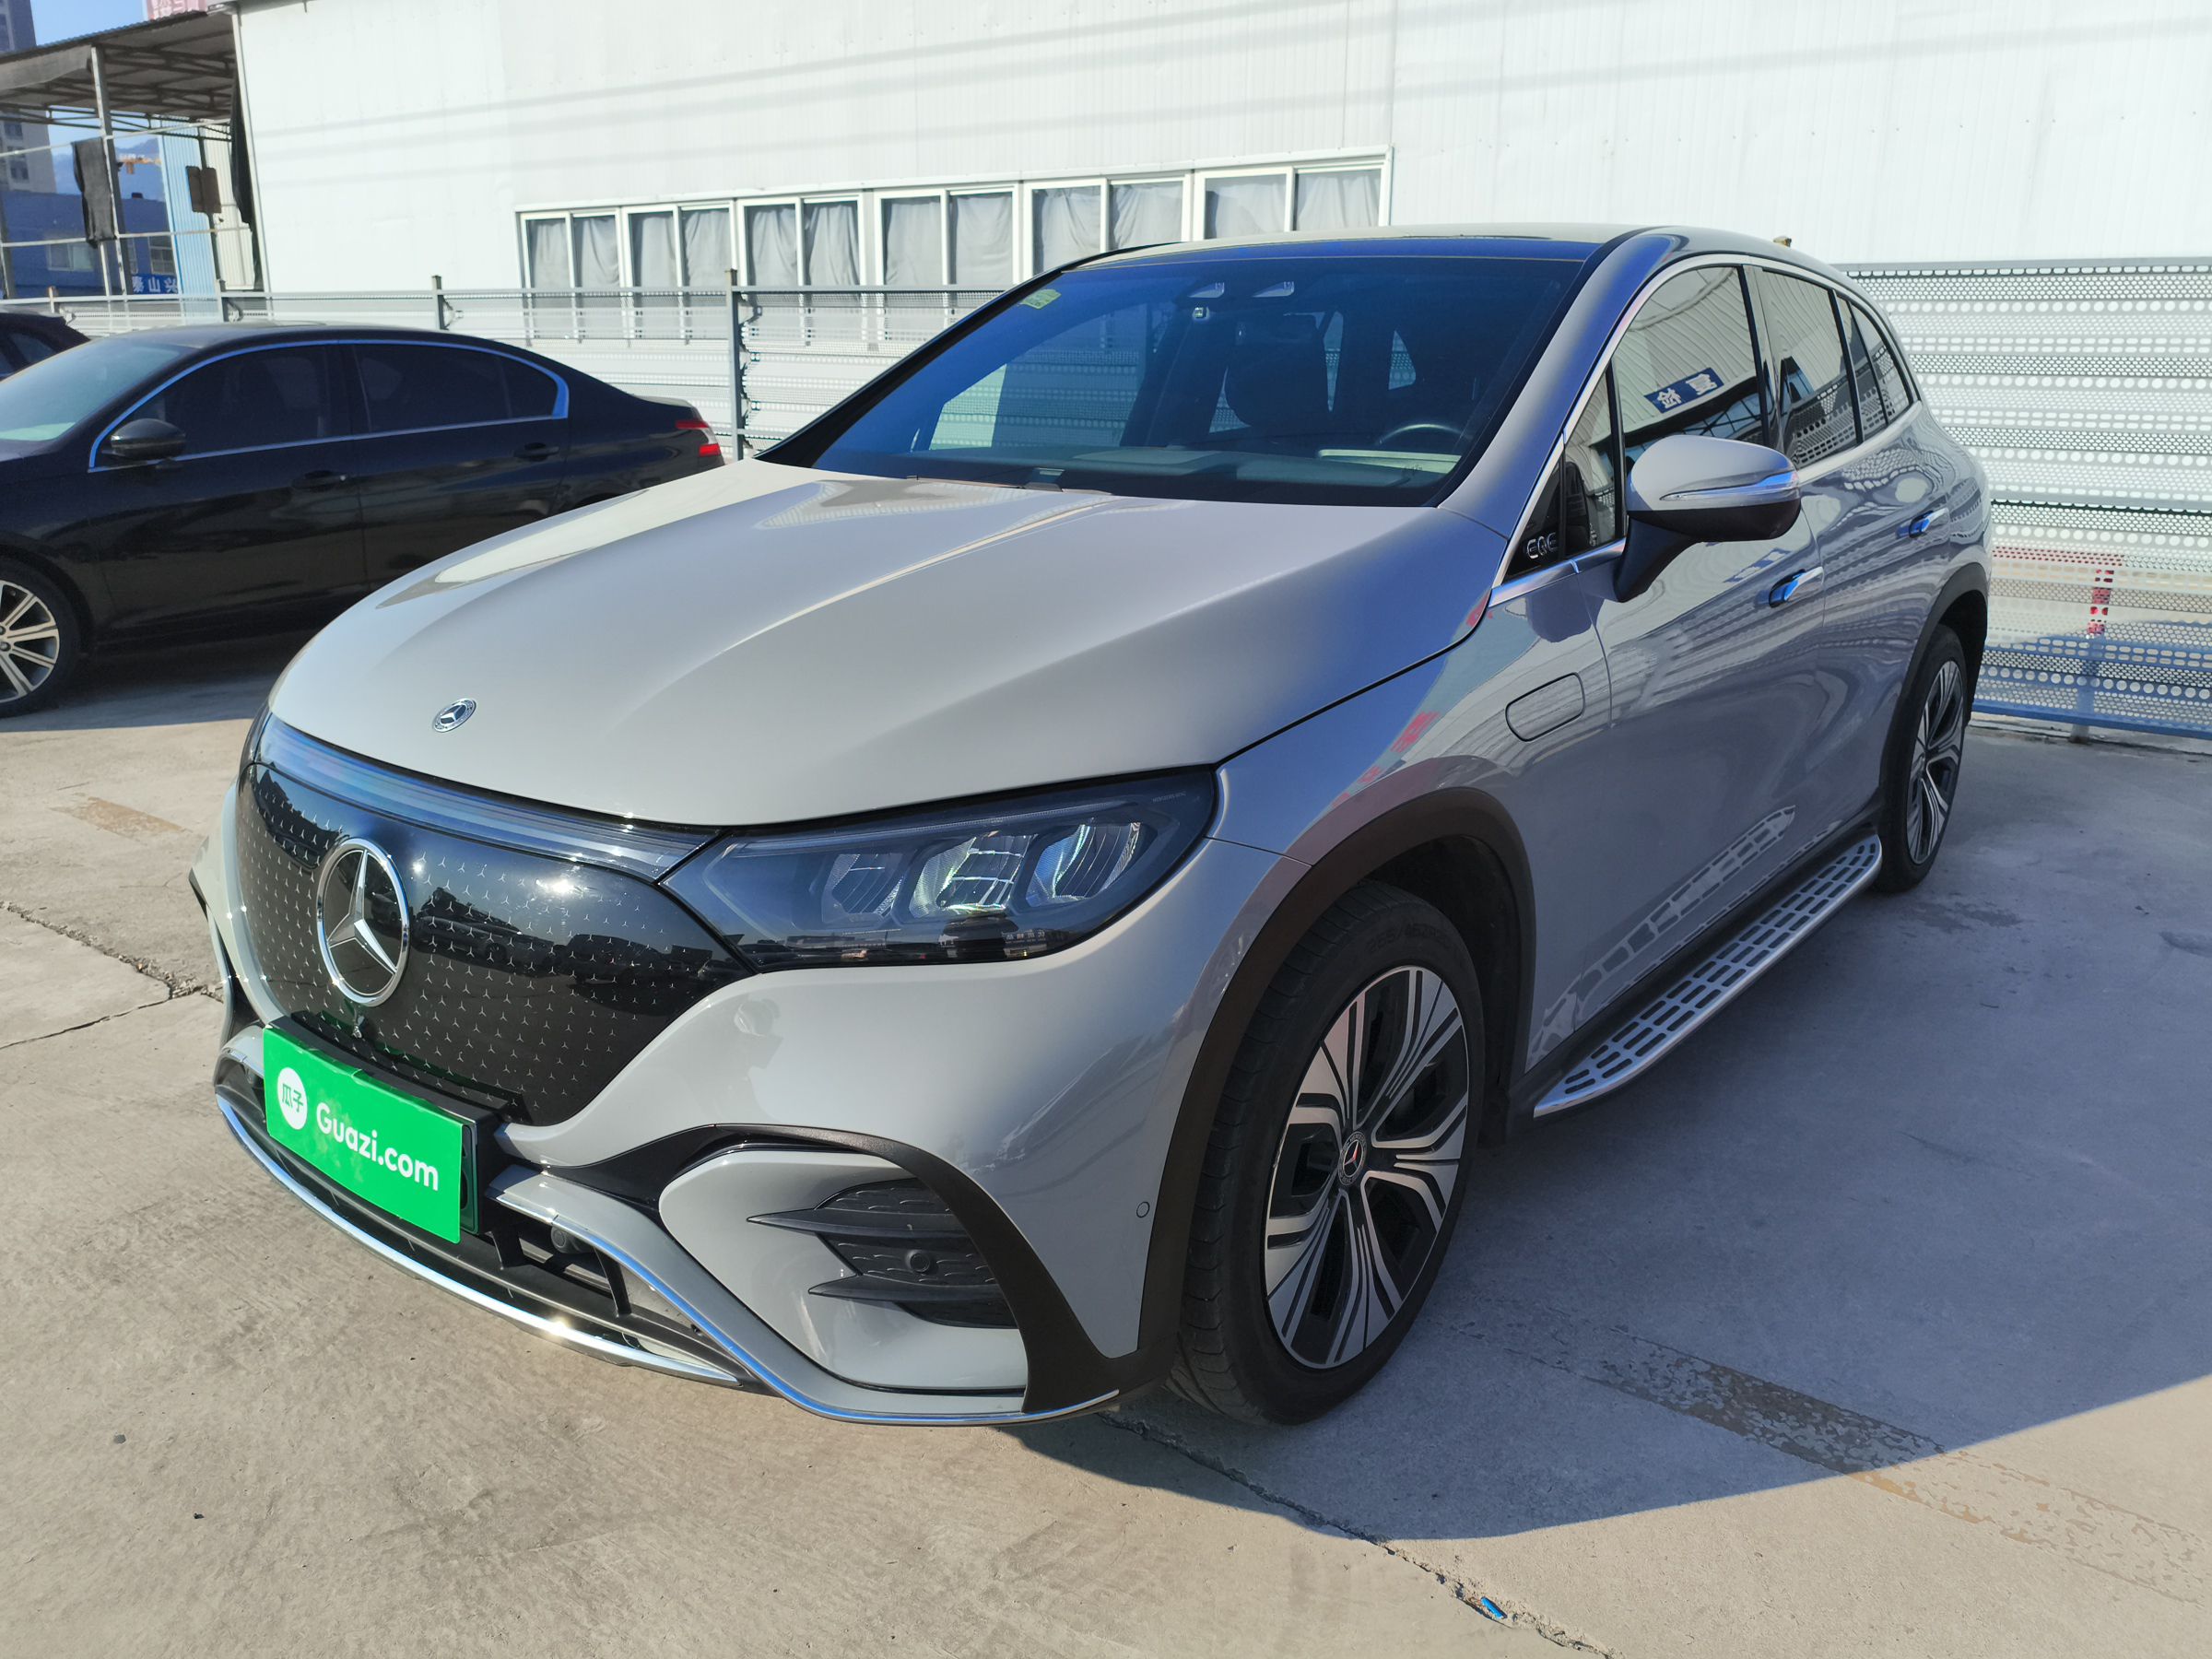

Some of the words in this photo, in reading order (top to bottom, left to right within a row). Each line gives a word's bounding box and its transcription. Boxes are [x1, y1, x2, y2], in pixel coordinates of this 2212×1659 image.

[1526, 532, 1557, 559] EQE
[281, 1083, 304, 1113] 瓜子
[316, 1102, 439, 1192] Guazi.com
